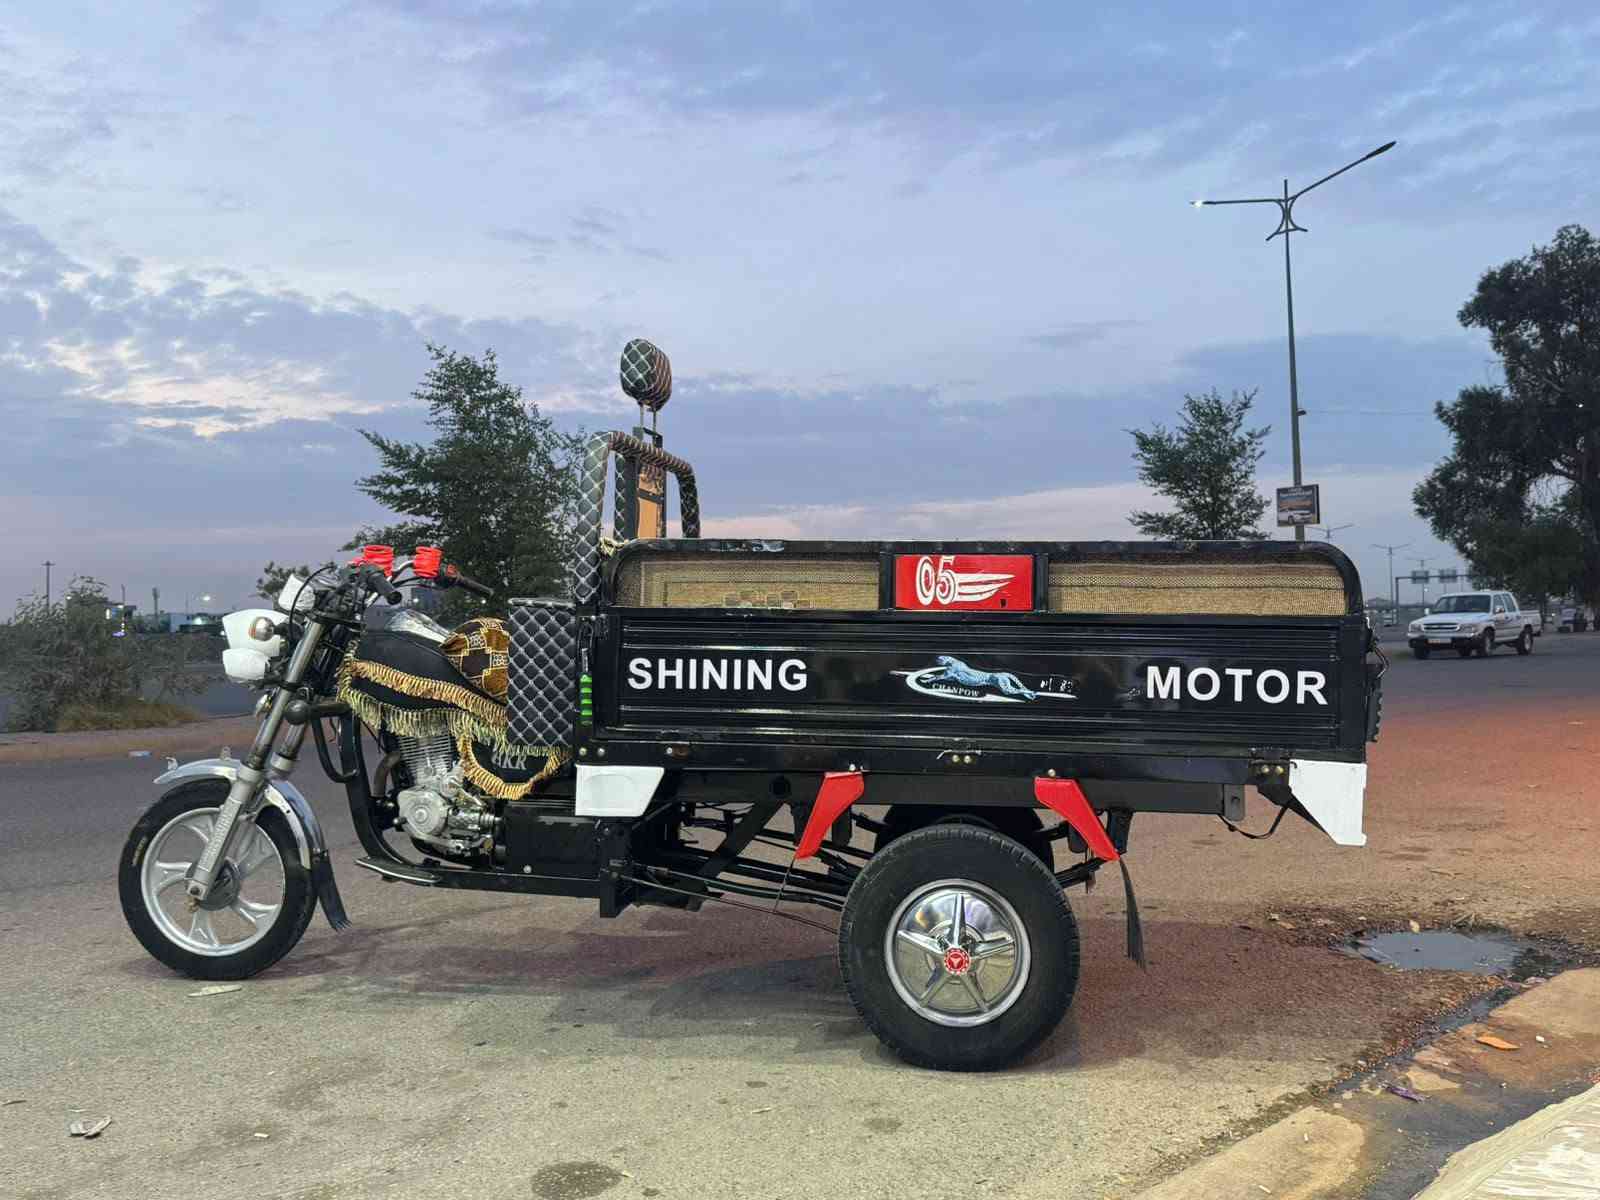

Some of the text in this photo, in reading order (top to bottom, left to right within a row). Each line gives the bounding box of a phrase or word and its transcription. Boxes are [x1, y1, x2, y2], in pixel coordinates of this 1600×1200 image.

[915, 555, 957, 606] 05
[627, 658, 1328, 705] SHINING MOTOR
